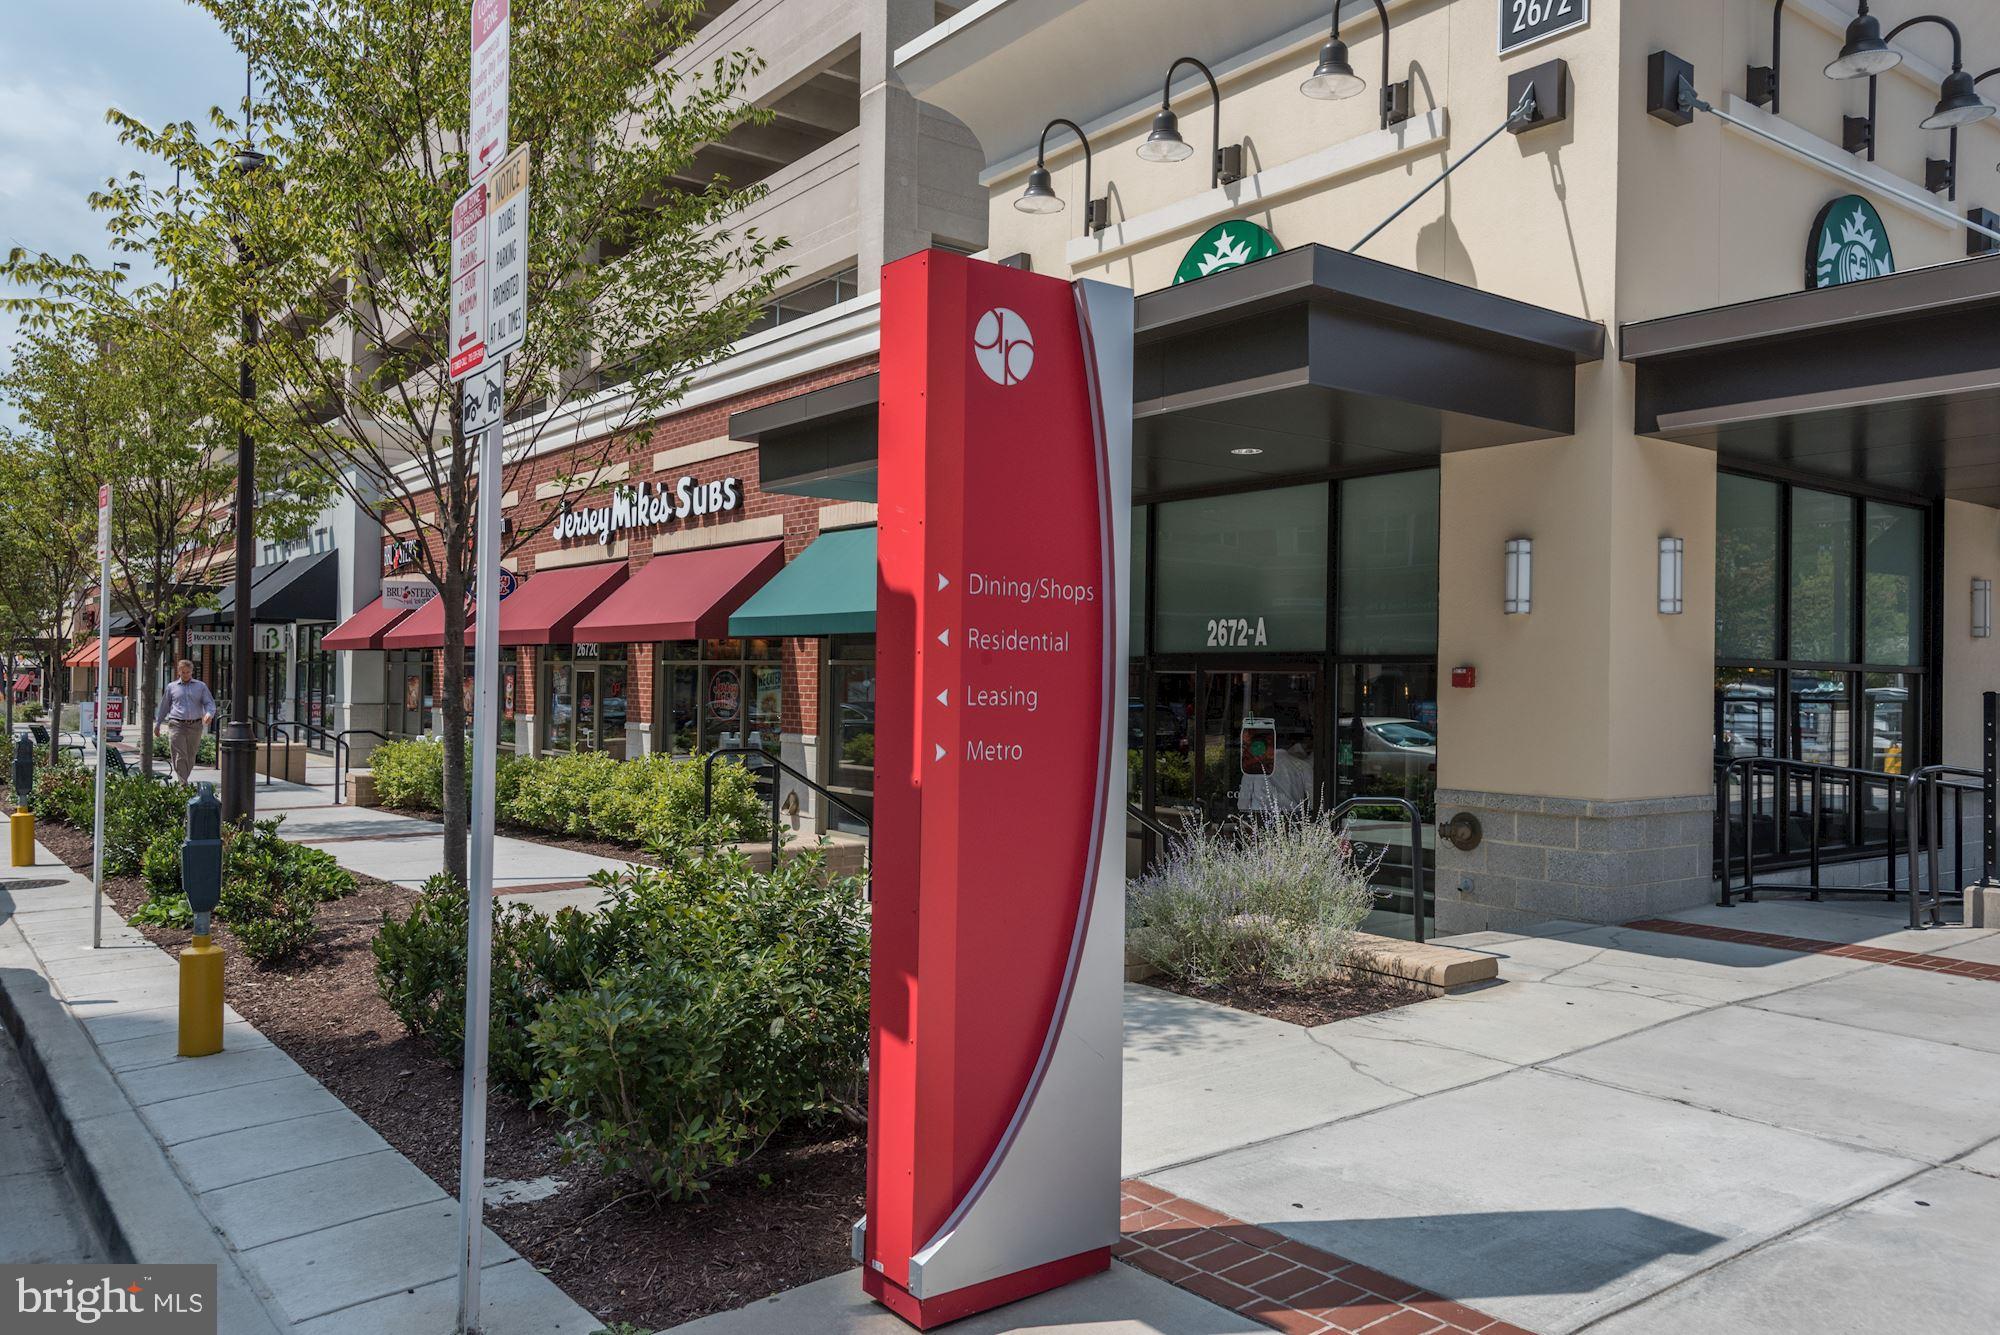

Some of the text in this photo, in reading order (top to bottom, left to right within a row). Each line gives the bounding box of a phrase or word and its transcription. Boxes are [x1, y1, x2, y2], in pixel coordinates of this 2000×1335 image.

[483, 4, 498, 35] ZONE
[495, 160, 521, 205] NOTICE
[458, 189, 480, 218] TOW ZONE
[463, 205, 483, 228] PARKING
[498, 203, 516, 237] DOUBLE
[460, 248, 478, 273] PARKING
[496, 239, 517, 273] PARKING
[493, 273, 519, 309] PROHIBITED
[490, 307, 522, 345] AT ALL TIMES
[552, 500, 610, 546] Jersey
[610, 481, 673, 531] Mike's
[969, 573, 1094, 605] Dining/Shops
[968, 628, 1069, 652] Residential
[1207, 617, 1267, 646] 2672-A
[577, 643, 599, 656] 2672C
[967, 685, 1038, 712] Leasing
[967, 740, 1023, 761] Metro
